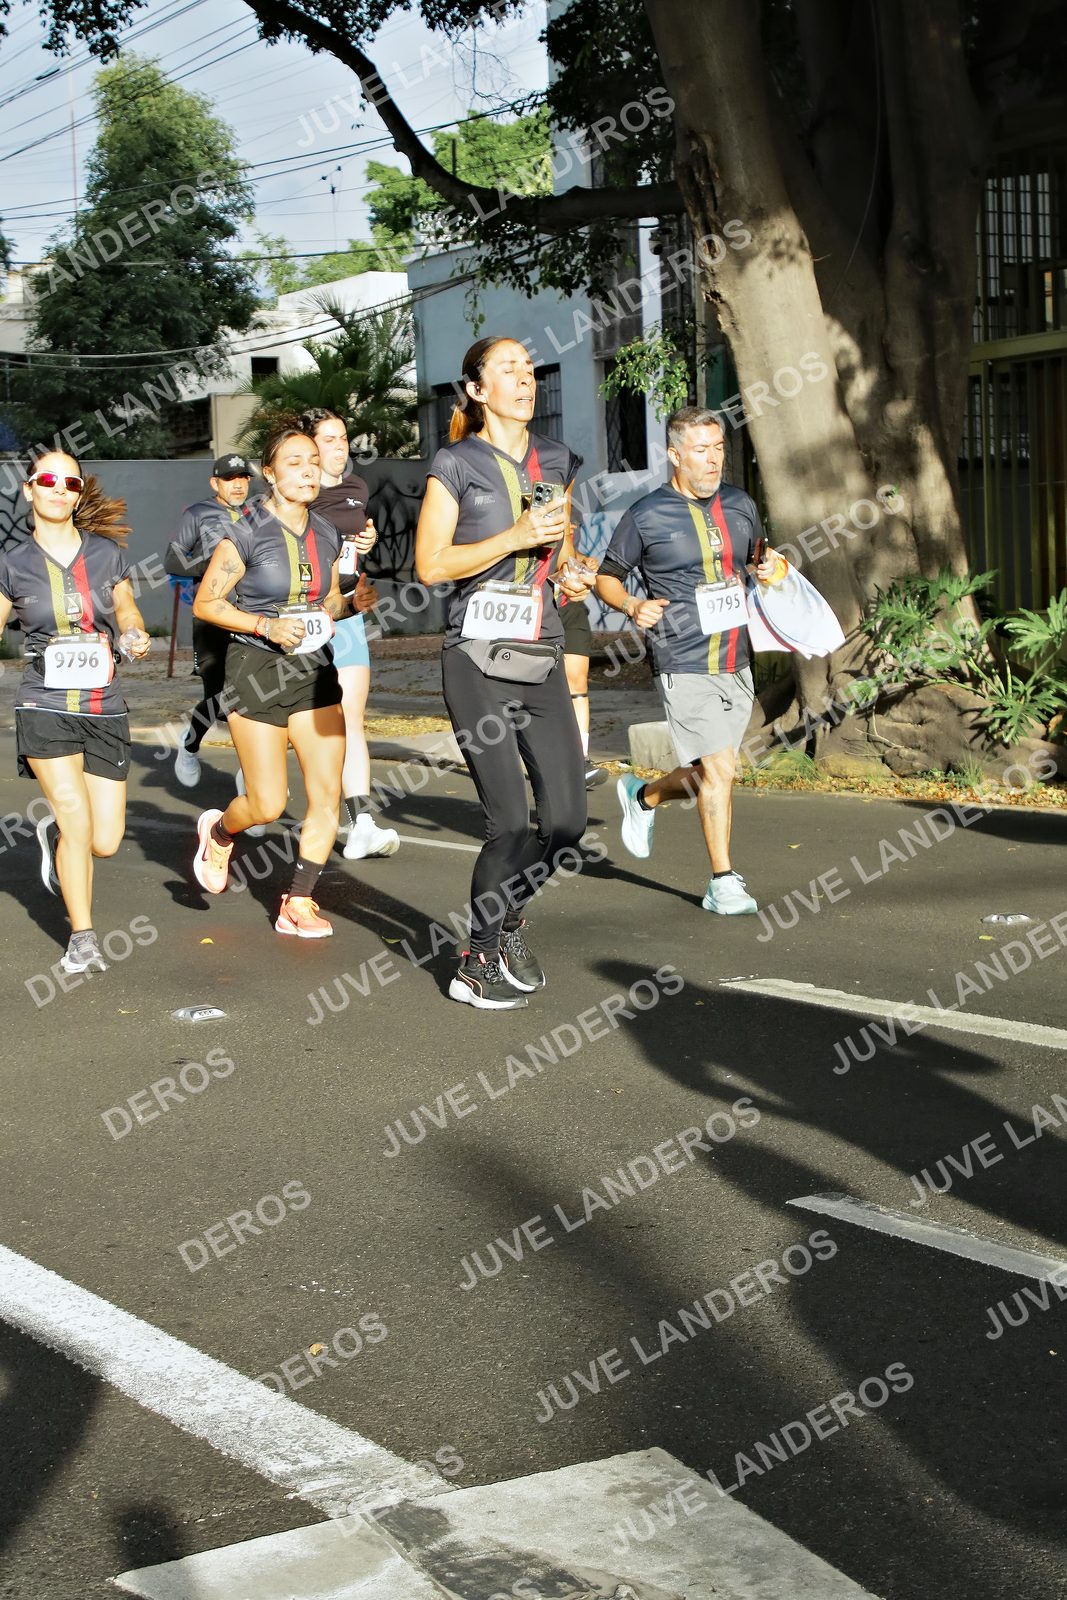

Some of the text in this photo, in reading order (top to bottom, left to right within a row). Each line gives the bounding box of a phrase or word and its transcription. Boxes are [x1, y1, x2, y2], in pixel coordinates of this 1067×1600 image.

[472, 599, 533, 625] 10874
[706, 593, 741, 615] 9795
[306, 618, 323, 636] 03
[54, 650, 100, 669] 9796
